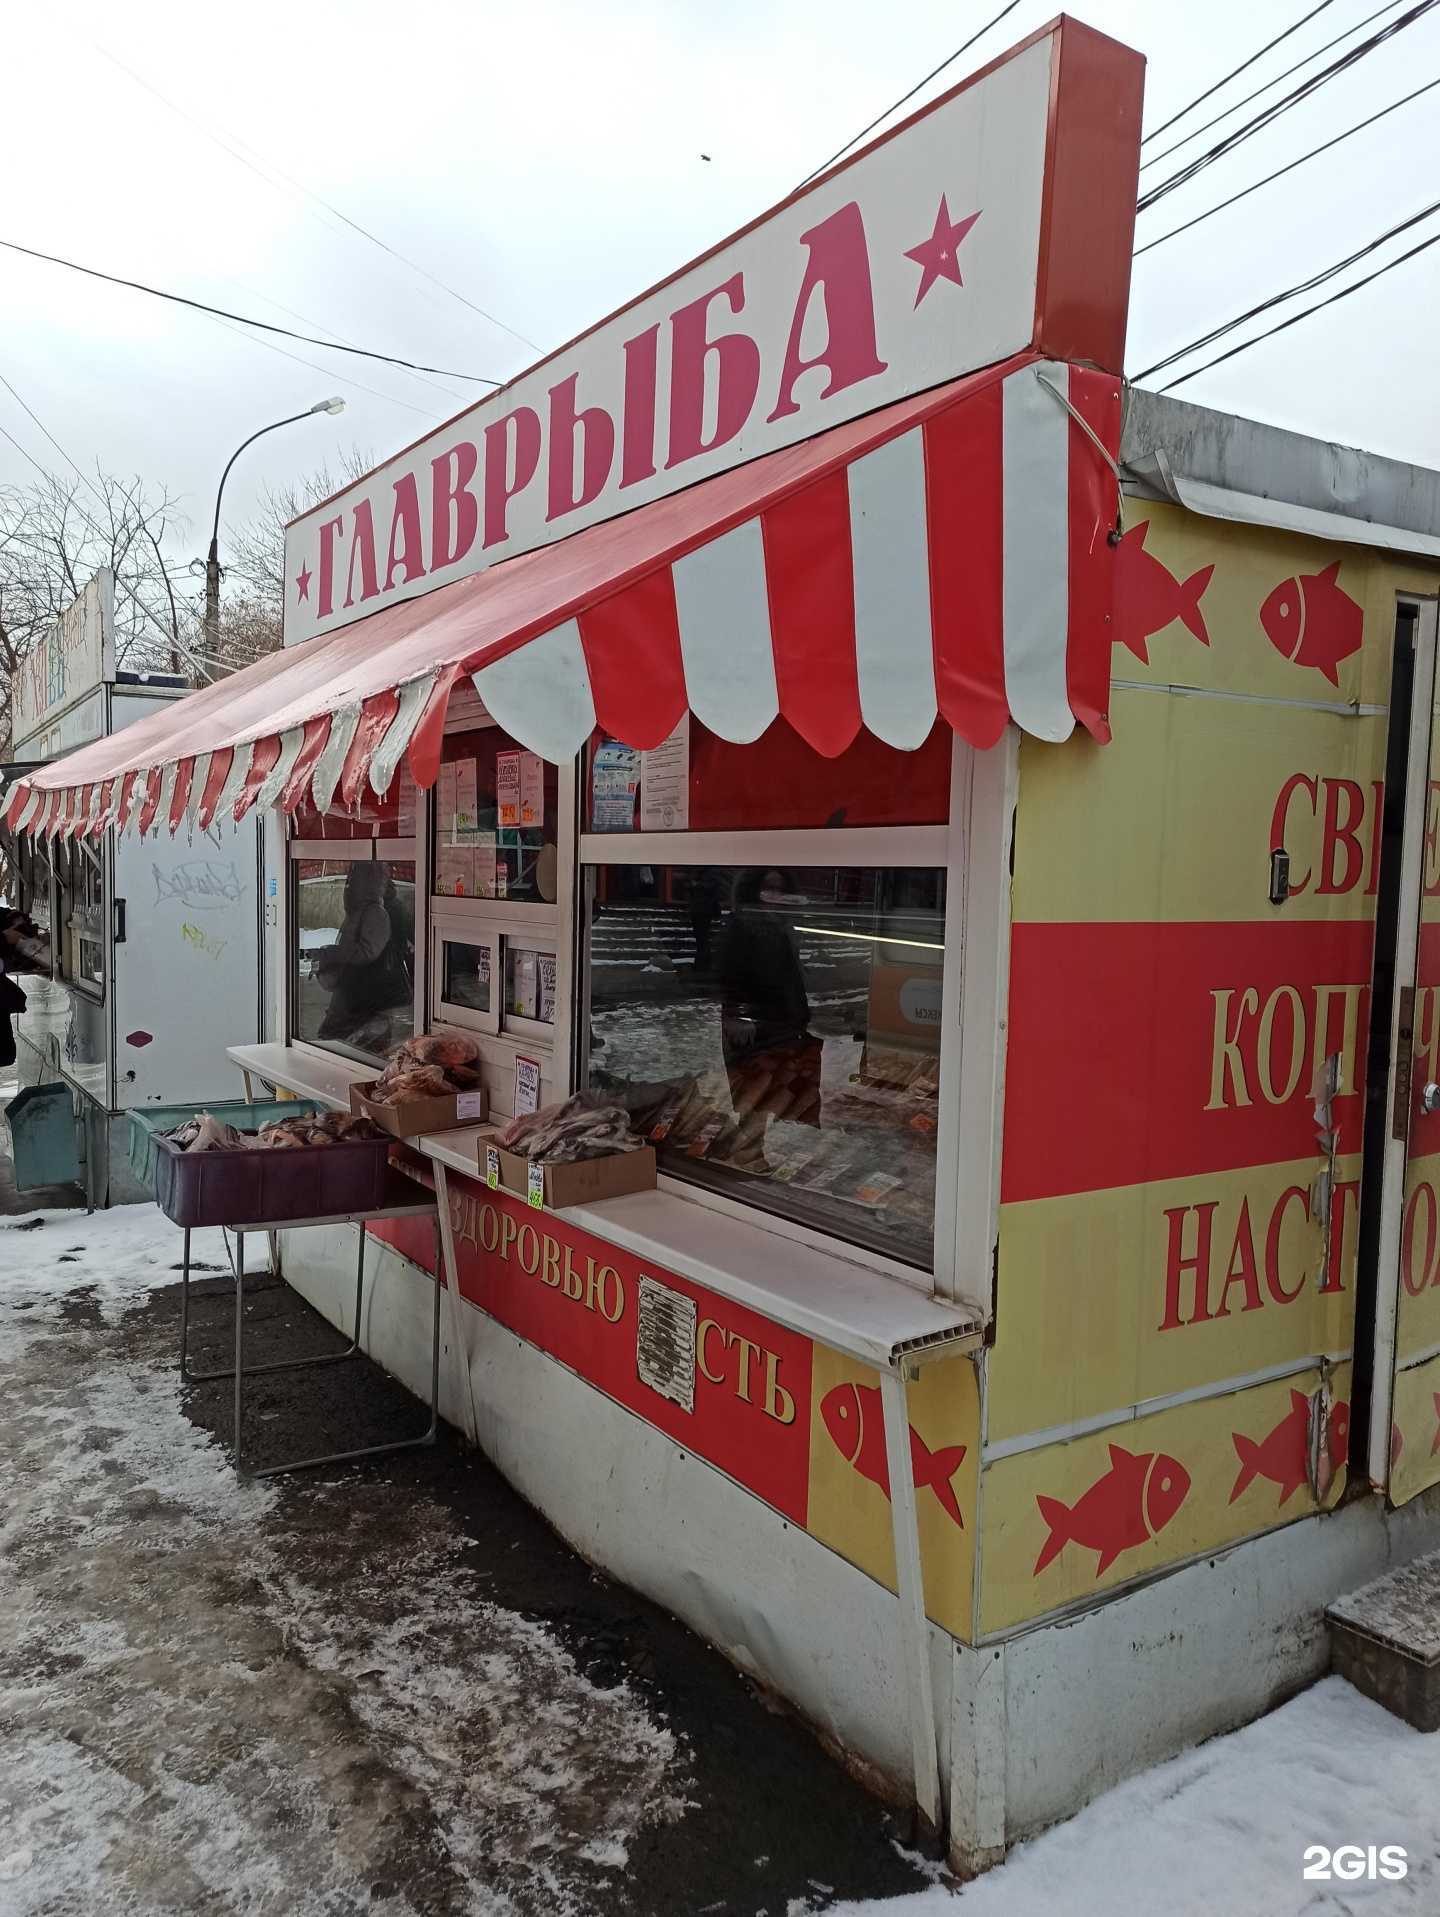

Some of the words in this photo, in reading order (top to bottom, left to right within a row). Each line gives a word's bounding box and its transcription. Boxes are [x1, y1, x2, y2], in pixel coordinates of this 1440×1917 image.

[317, 201, 888, 619] ГЛАВРЫБА
[1158, 1180, 1440, 1331] НАСТО
[697, 1319, 796, 1424] СТЬ
